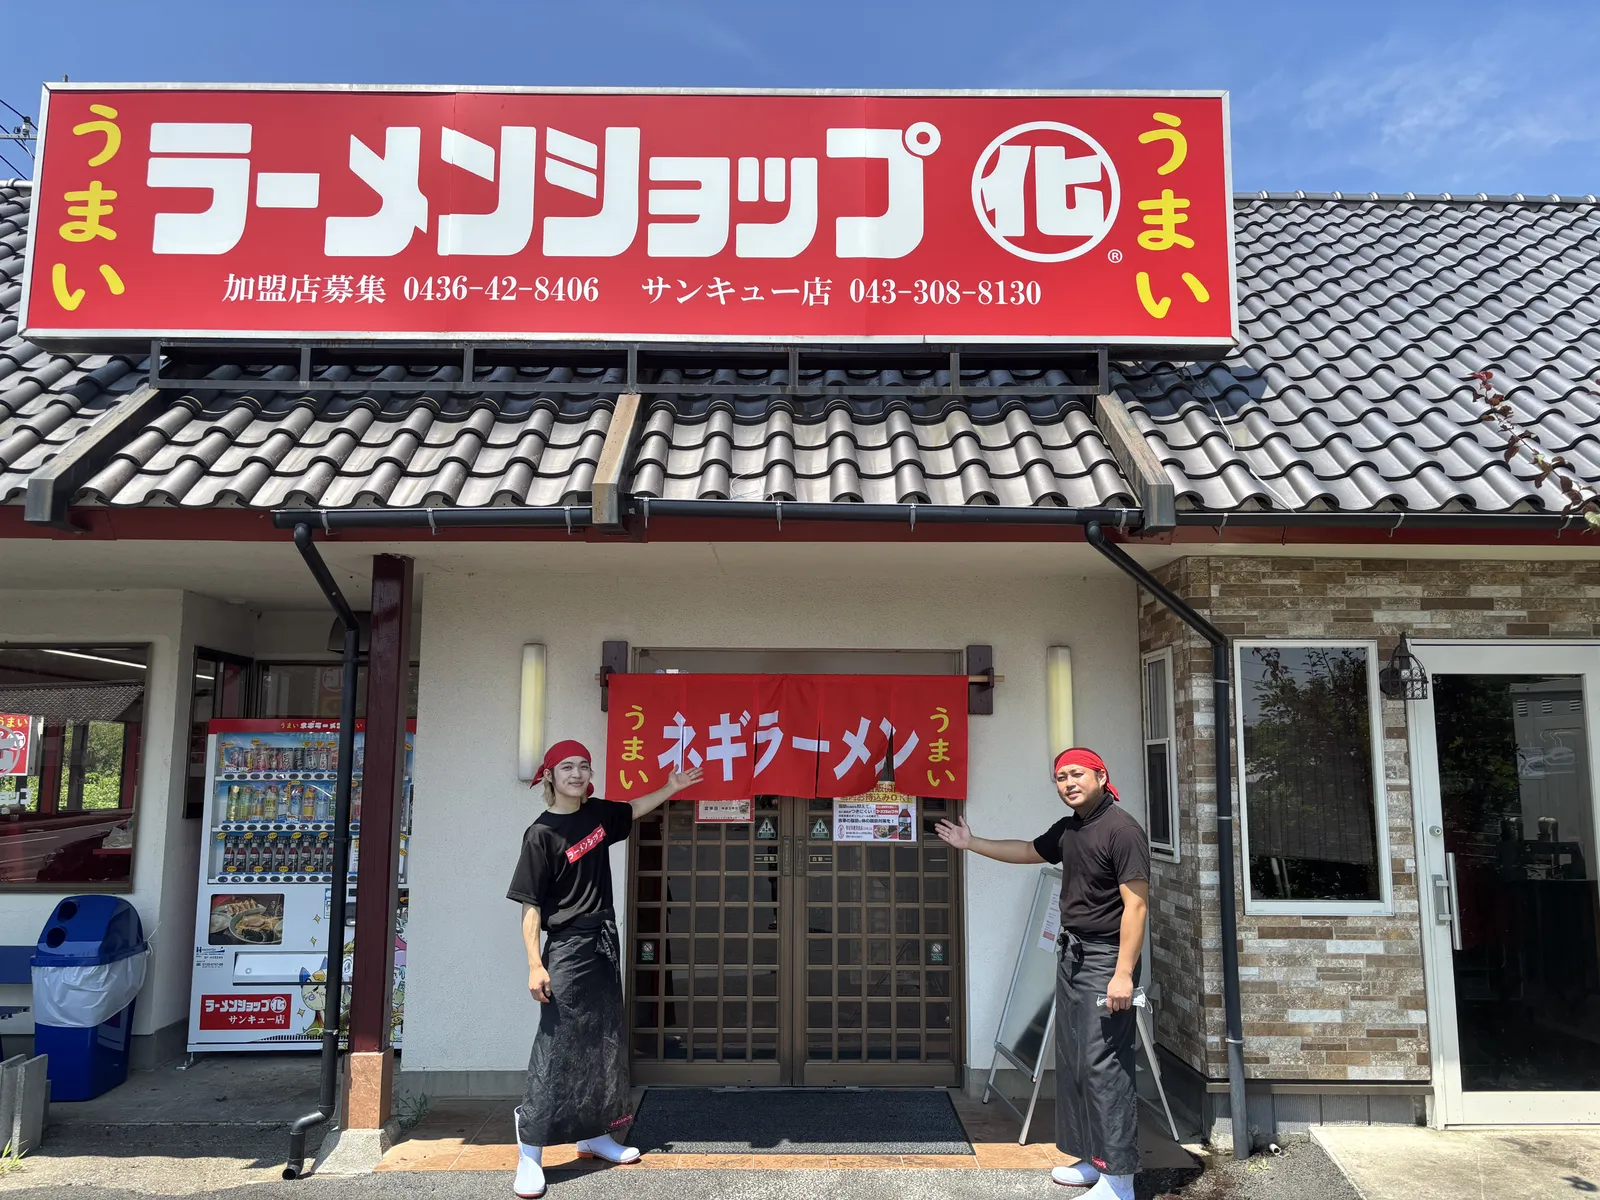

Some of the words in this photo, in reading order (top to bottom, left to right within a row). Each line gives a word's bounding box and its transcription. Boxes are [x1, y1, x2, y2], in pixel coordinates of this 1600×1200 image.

[52, 104, 125, 311] うまい
[147, 121, 941, 259] ラーメンショップ
[1136, 112, 1210, 319] うまい
[222, 273, 386, 304] 加盟店募集
[403, 275, 599, 302] 0436-42-8406
[641, 276, 832, 307] サンキュー店
[849, 278, 1042, 305] 043-308-8130
[619, 704, 649, 790] うまい
[657, 709, 920, 782] ネギラーメン
[927, 706, 956, 787] うまい
[205, 999, 271, 1012] ラーメンショップ
[228, 1014, 285, 1025] サンキュー店
